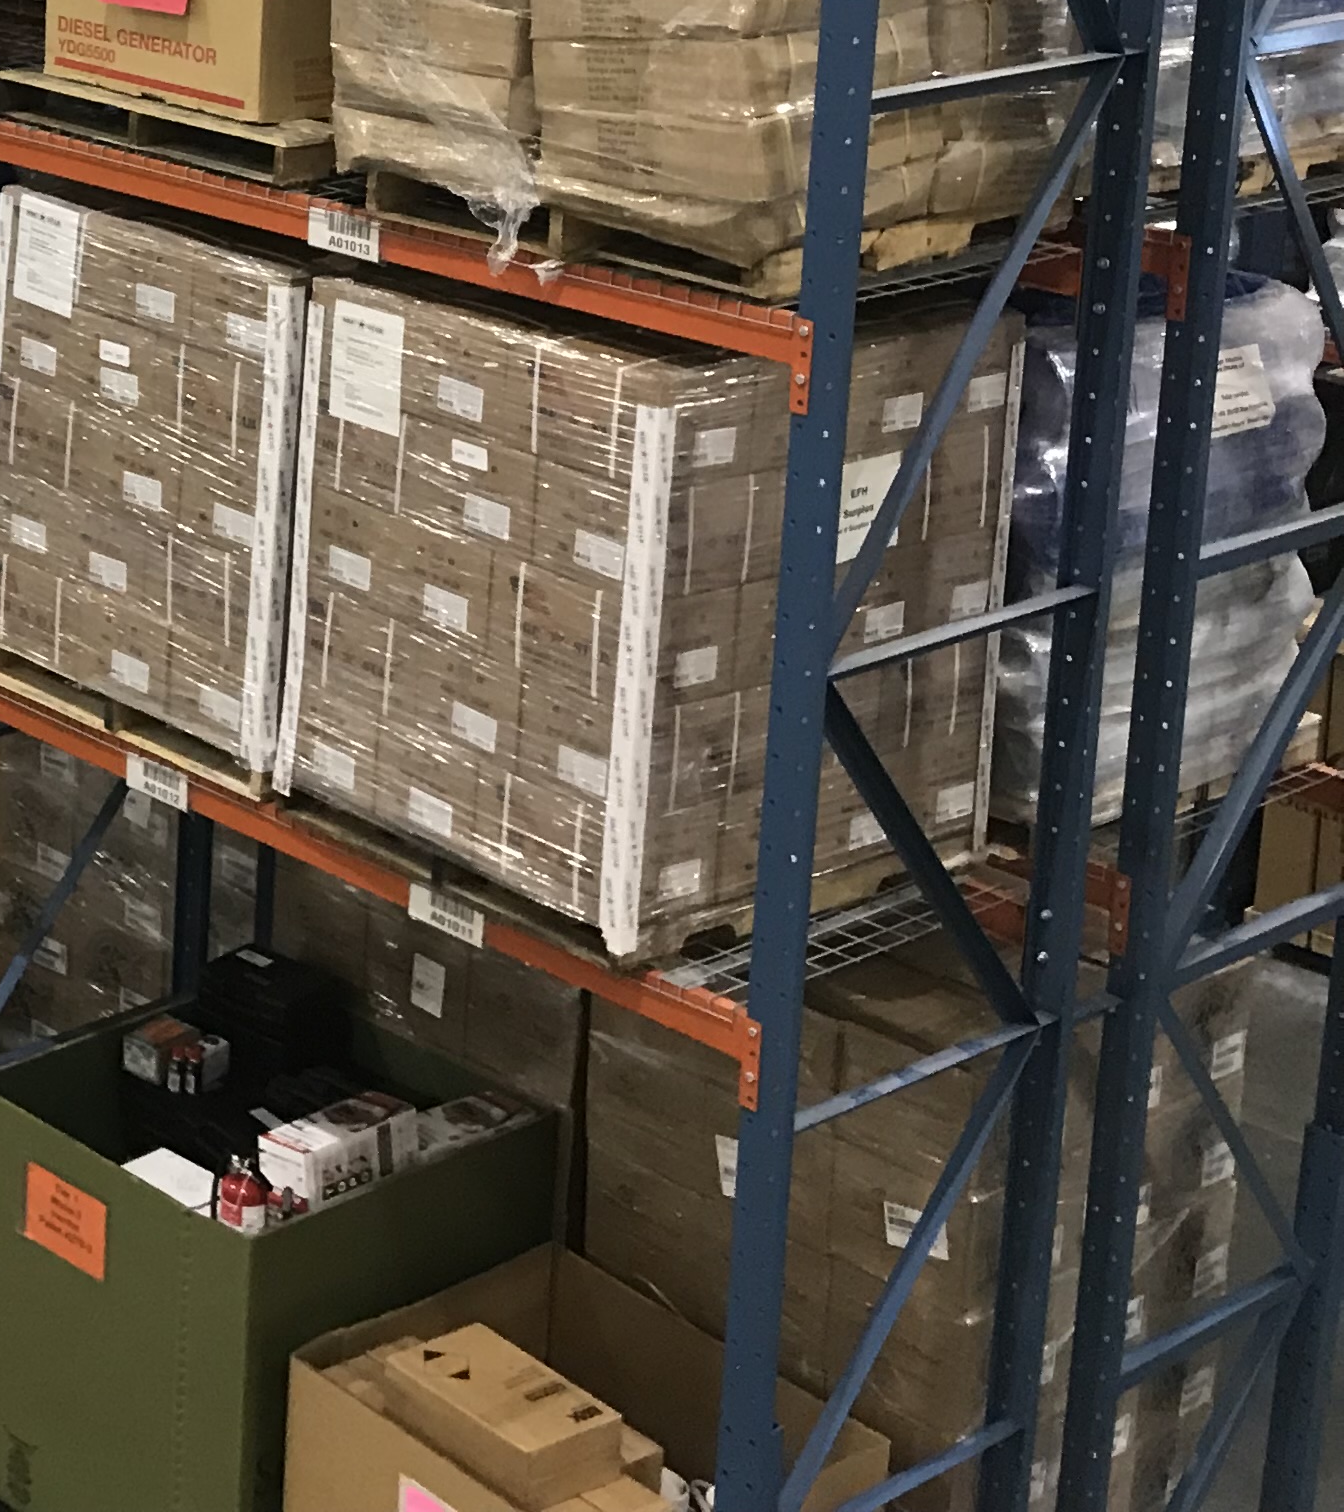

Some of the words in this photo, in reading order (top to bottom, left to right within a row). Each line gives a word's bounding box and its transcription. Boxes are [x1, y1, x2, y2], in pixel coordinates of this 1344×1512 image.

[57, 15, 112, 43] DIESEL
[116, 28, 217, 66] GENERATOR
[57, 38, 116, 64] YDG5500
[328, 235, 370, 256] A01013
[850, 486, 868, 499] EFH
